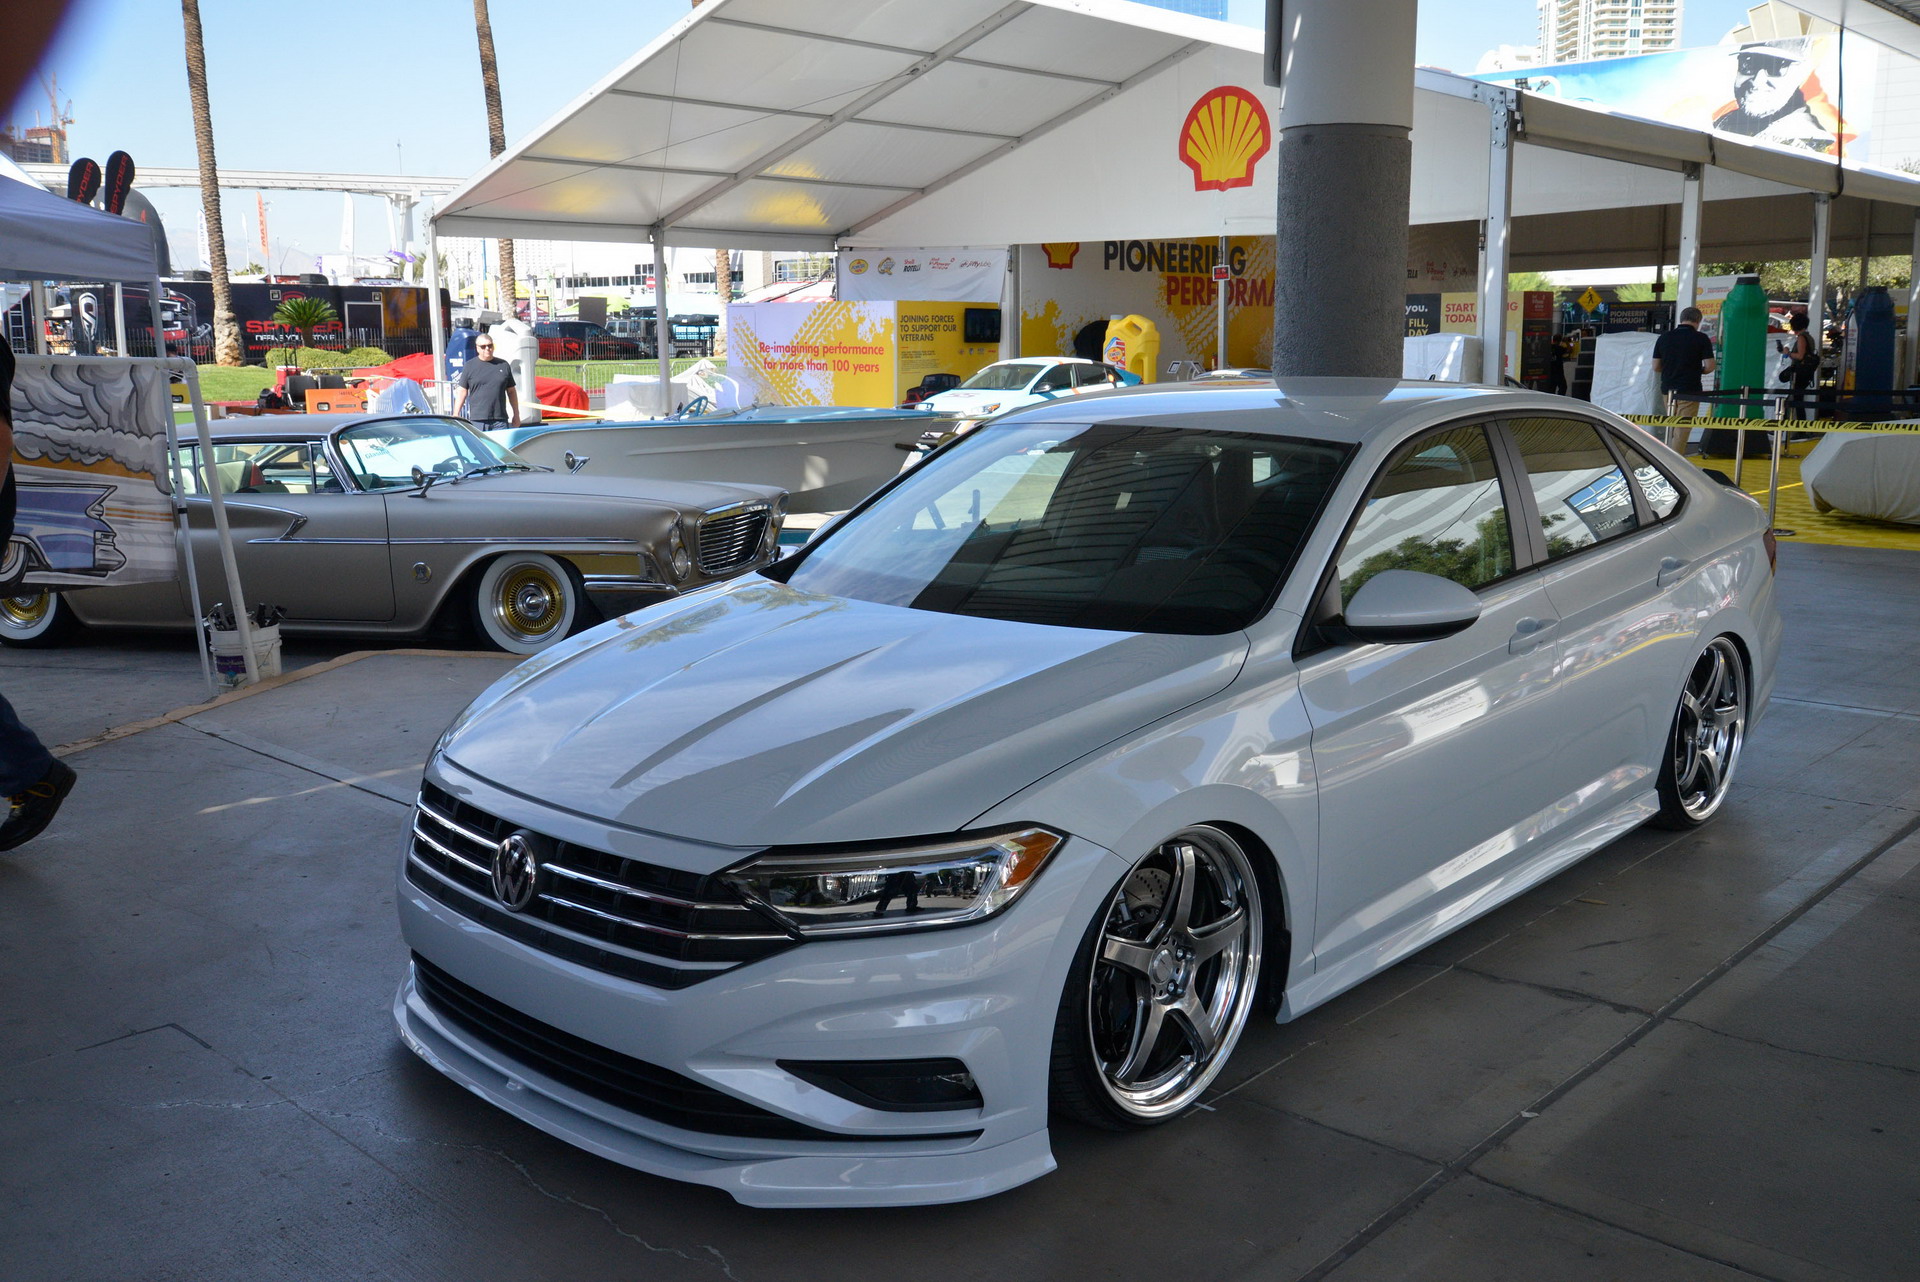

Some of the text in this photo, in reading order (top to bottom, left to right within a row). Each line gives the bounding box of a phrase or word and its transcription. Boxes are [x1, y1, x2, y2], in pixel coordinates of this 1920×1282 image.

[76, 161, 93, 203] PYDER
[110, 155, 129, 214] SPYDER
[1405, 305, 1428, 315] you.
[1445, 303, 1475, 313] START
[900, 315, 955, 323] JOINING FORCES
[1445, 313, 1478, 323] TODAY
[246, 320, 344, 333] SPYER
[1408, 319, 1429, 328] FILL,
[900, 334, 935, 342] VETERANS
[1408, 329, 1428, 337] DAY
[759, 341, 820, 357] Re-imagining
[822, 341, 885, 357] performance
[763, 358, 880, 375] for more than 100 years
[1691, 416, 1749, 427] CAUTION
